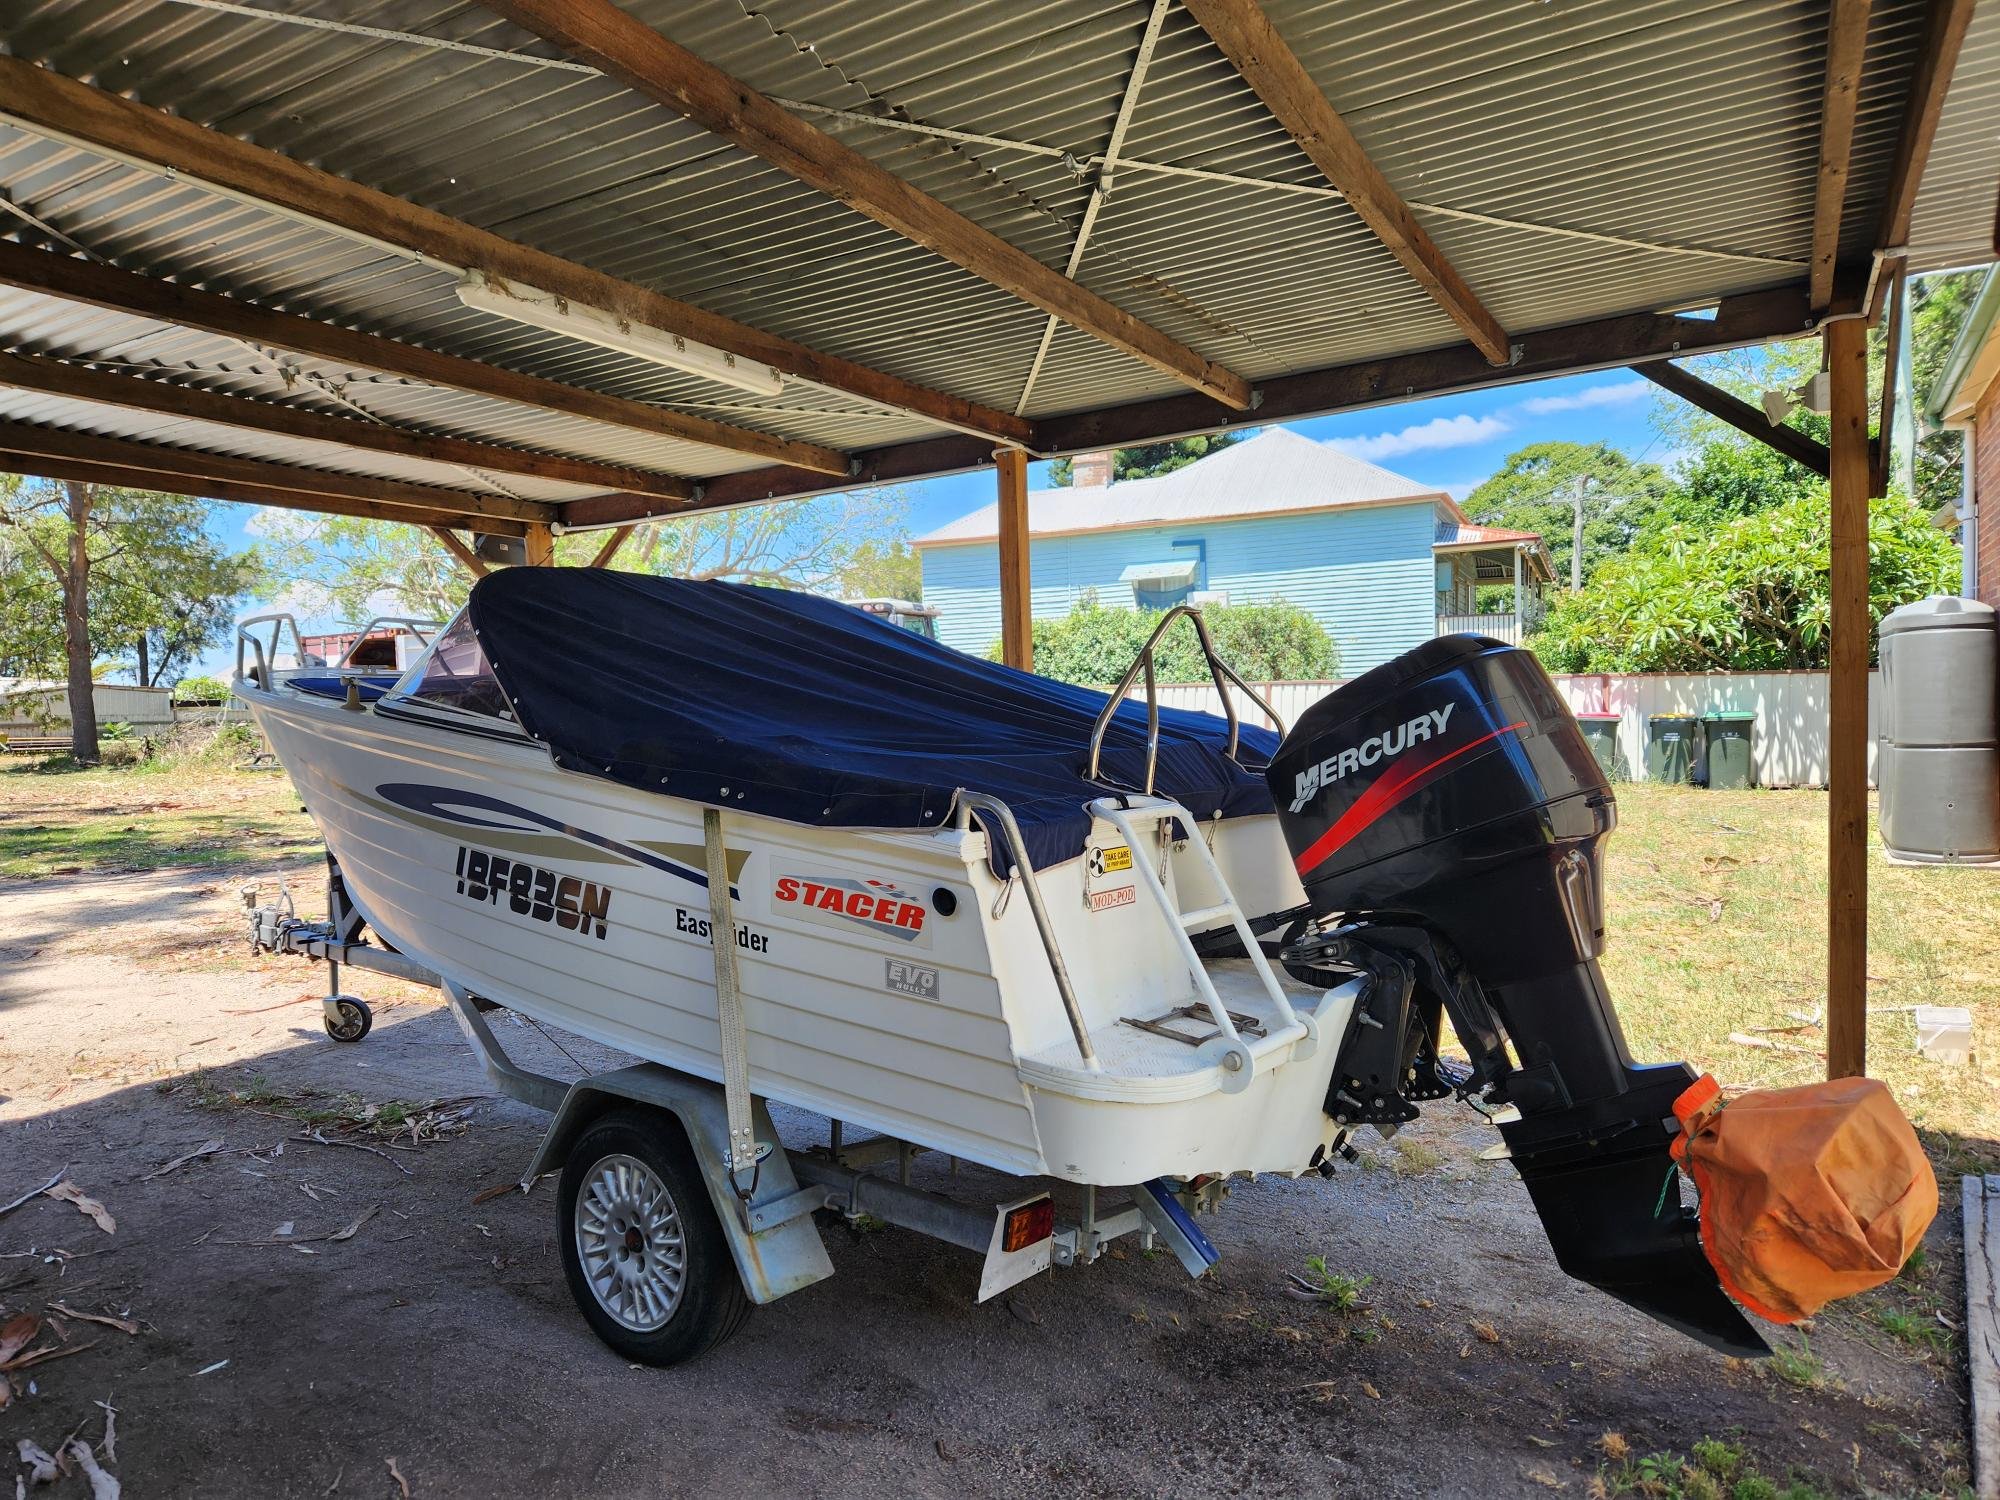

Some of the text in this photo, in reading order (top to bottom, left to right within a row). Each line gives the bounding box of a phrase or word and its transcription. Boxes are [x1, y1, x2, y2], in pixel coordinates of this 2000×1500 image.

[1288, 702, 1456, 814] MERCURY
[1104, 850, 1130, 861] TAKE CARE
[775, 878, 926, 931] STACER
[1093, 888, 1134, 910] MOD-POD
[732, 922, 769, 953] ider
[896, 981, 927, 995] HULLS
